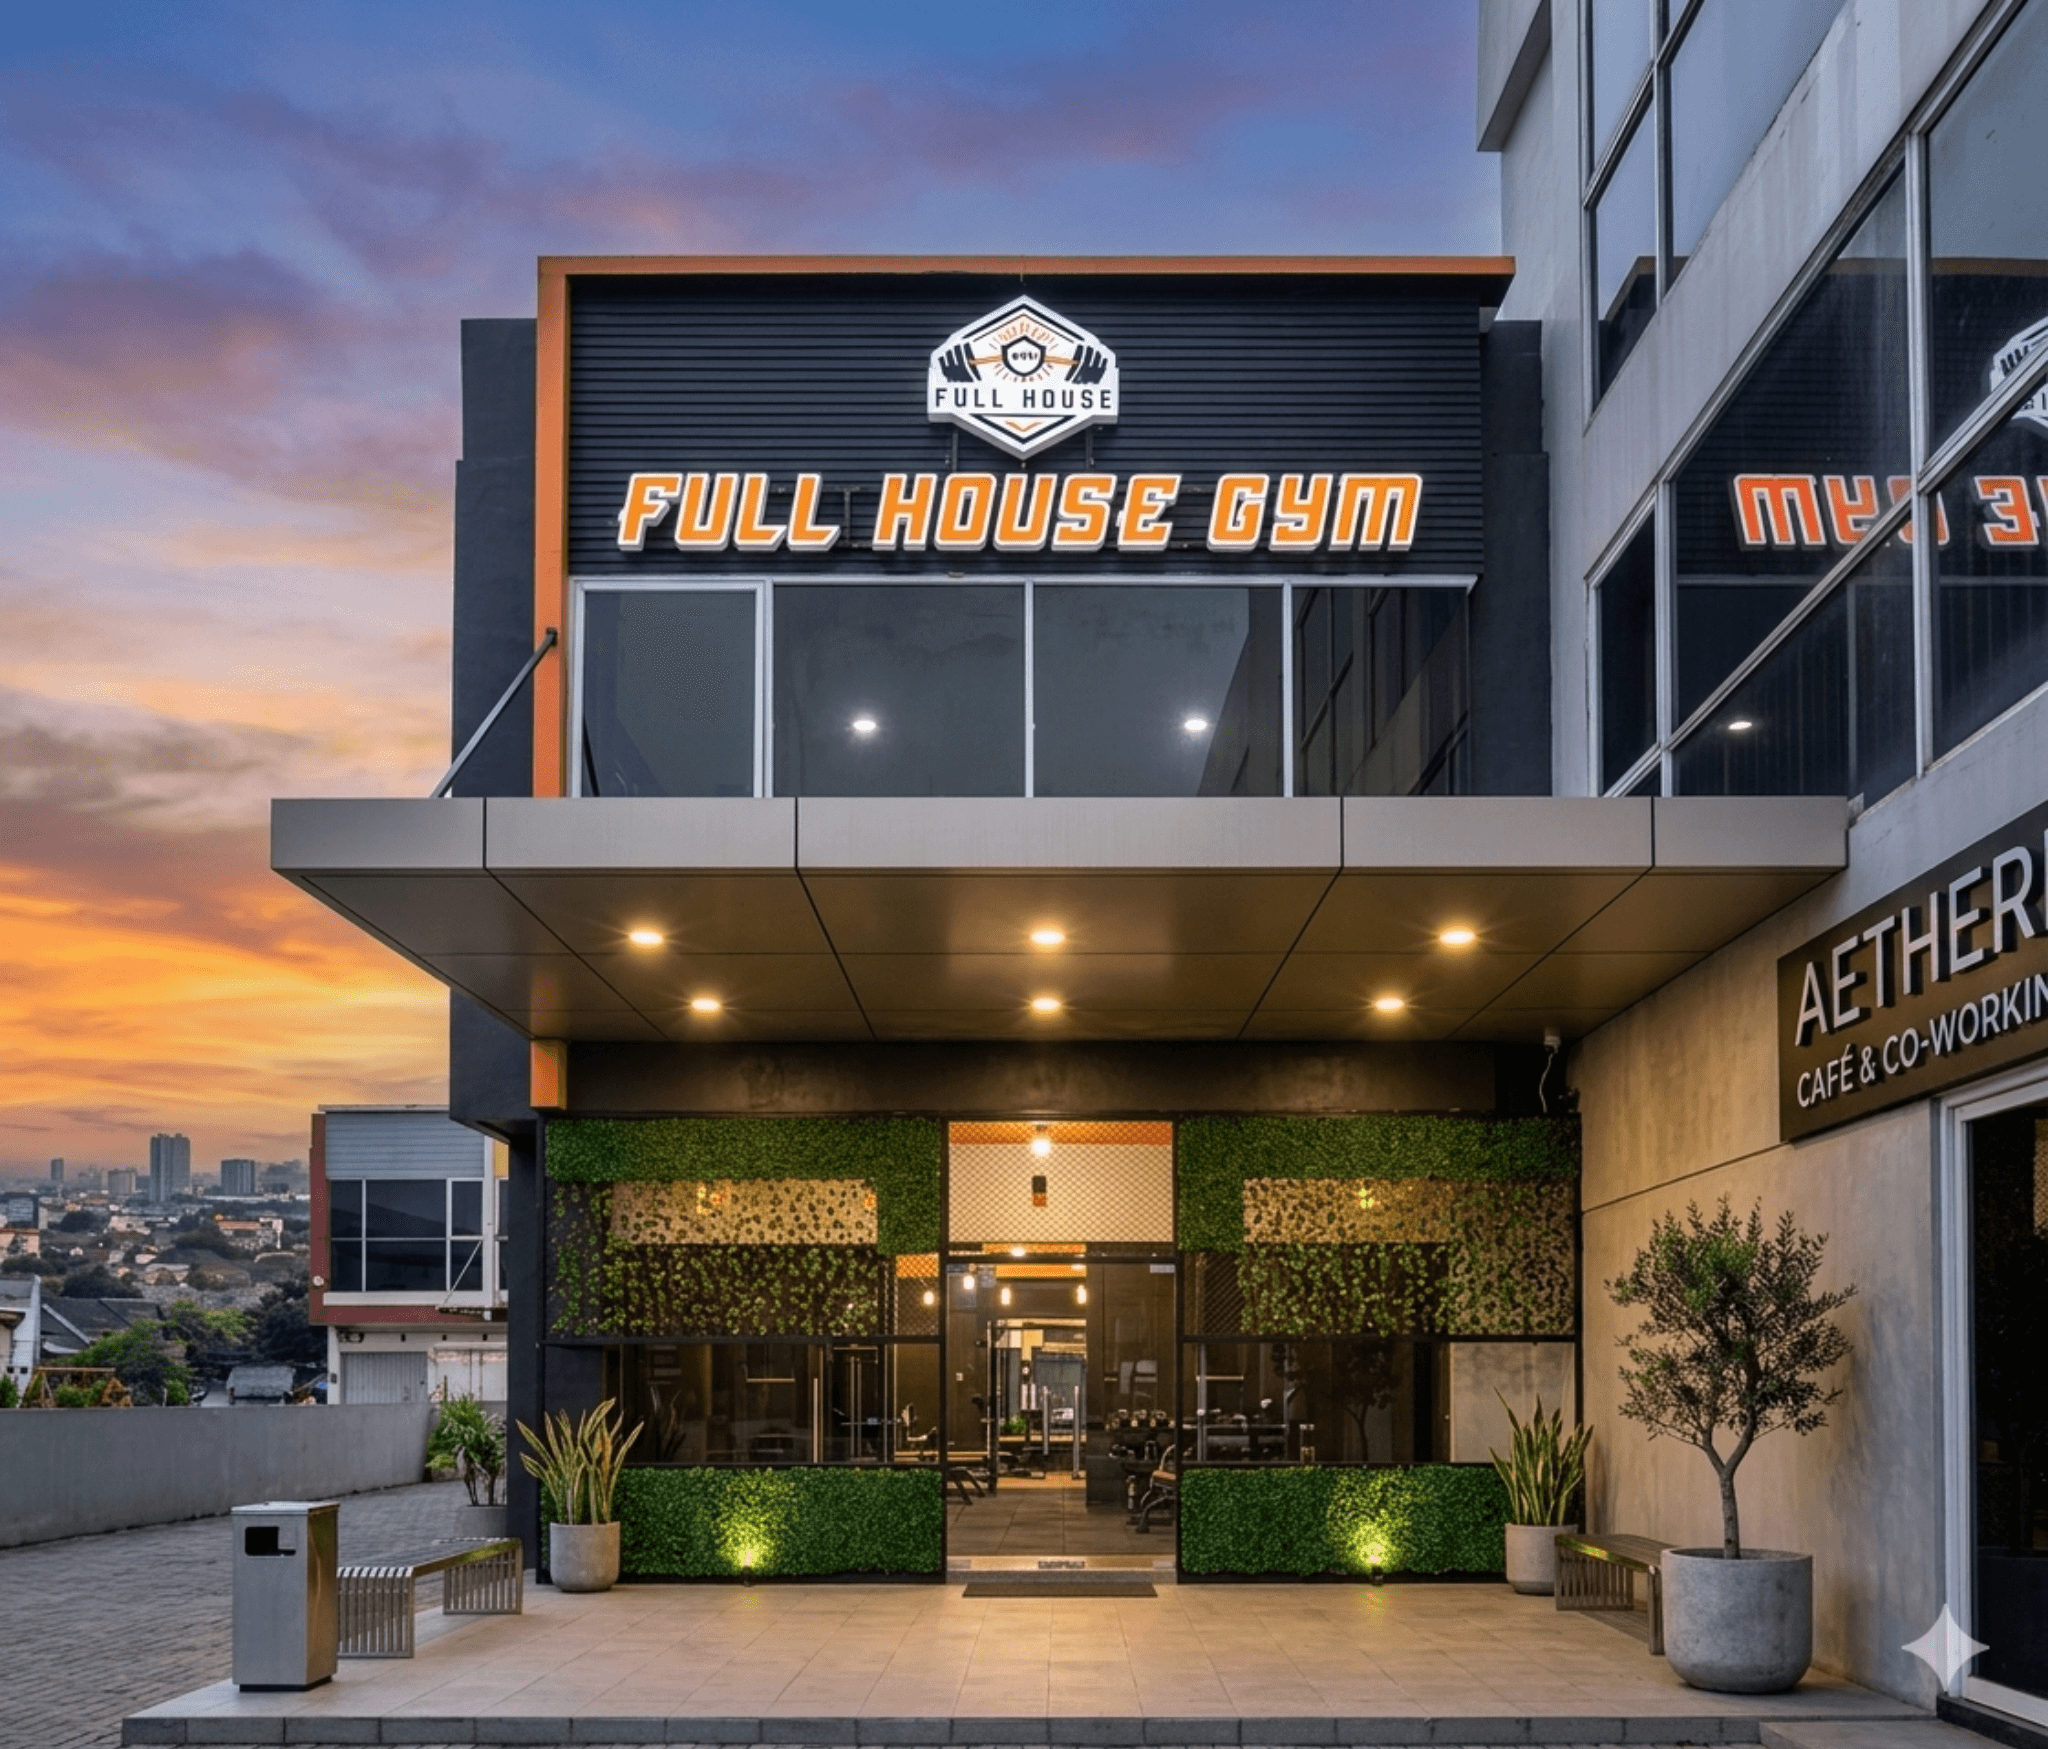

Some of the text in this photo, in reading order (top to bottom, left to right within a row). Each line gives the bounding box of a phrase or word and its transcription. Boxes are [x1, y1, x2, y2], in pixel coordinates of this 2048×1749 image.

[935, 387, 1112, 409] FULL HOUSE
[617, 473, 1423, 551] FULL HOUSE GYM
[1795, 828, 2048, 1046] AETHER
[1797, 1045, 1854, 1108] CAFÉ
[1860, 1046, 1877, 1084] &
